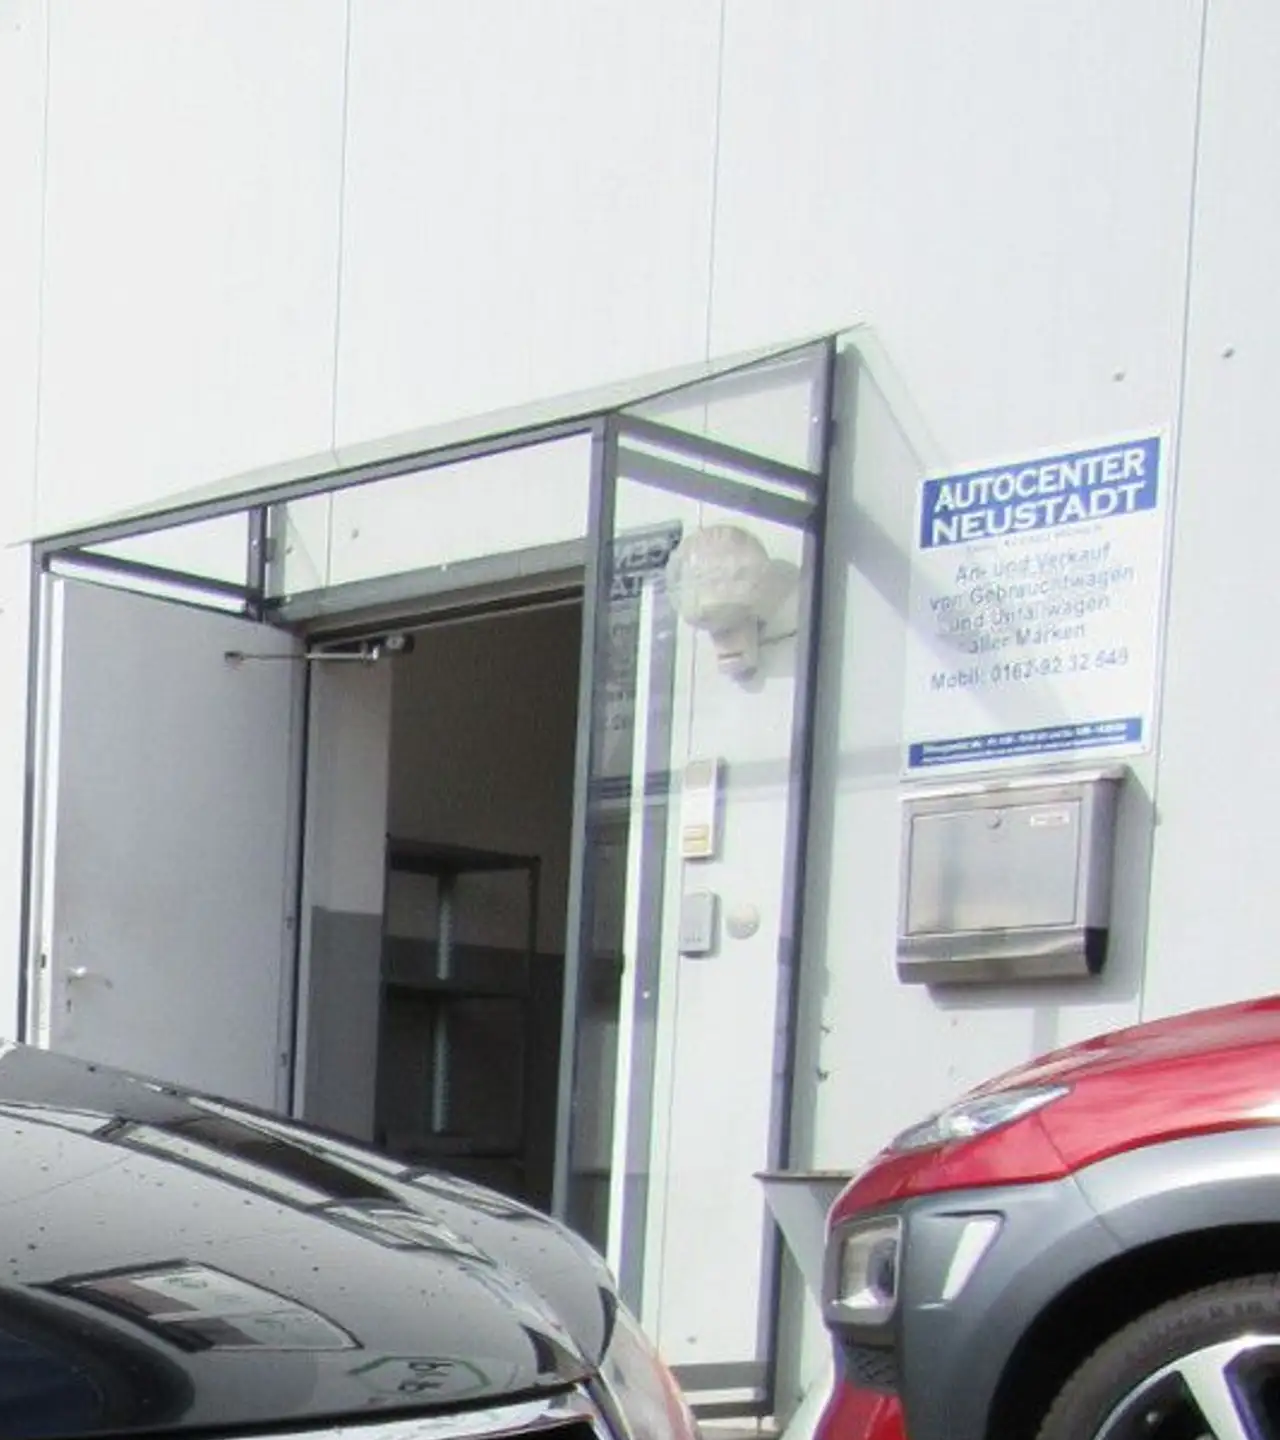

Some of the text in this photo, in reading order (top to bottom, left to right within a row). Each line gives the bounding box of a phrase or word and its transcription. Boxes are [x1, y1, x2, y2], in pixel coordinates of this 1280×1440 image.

[935, 448, 1145, 513] AUTOCENTER
[932, 481, 1146, 545] NEUSTADT
[1035, 541, 1111, 572] Verkauf
